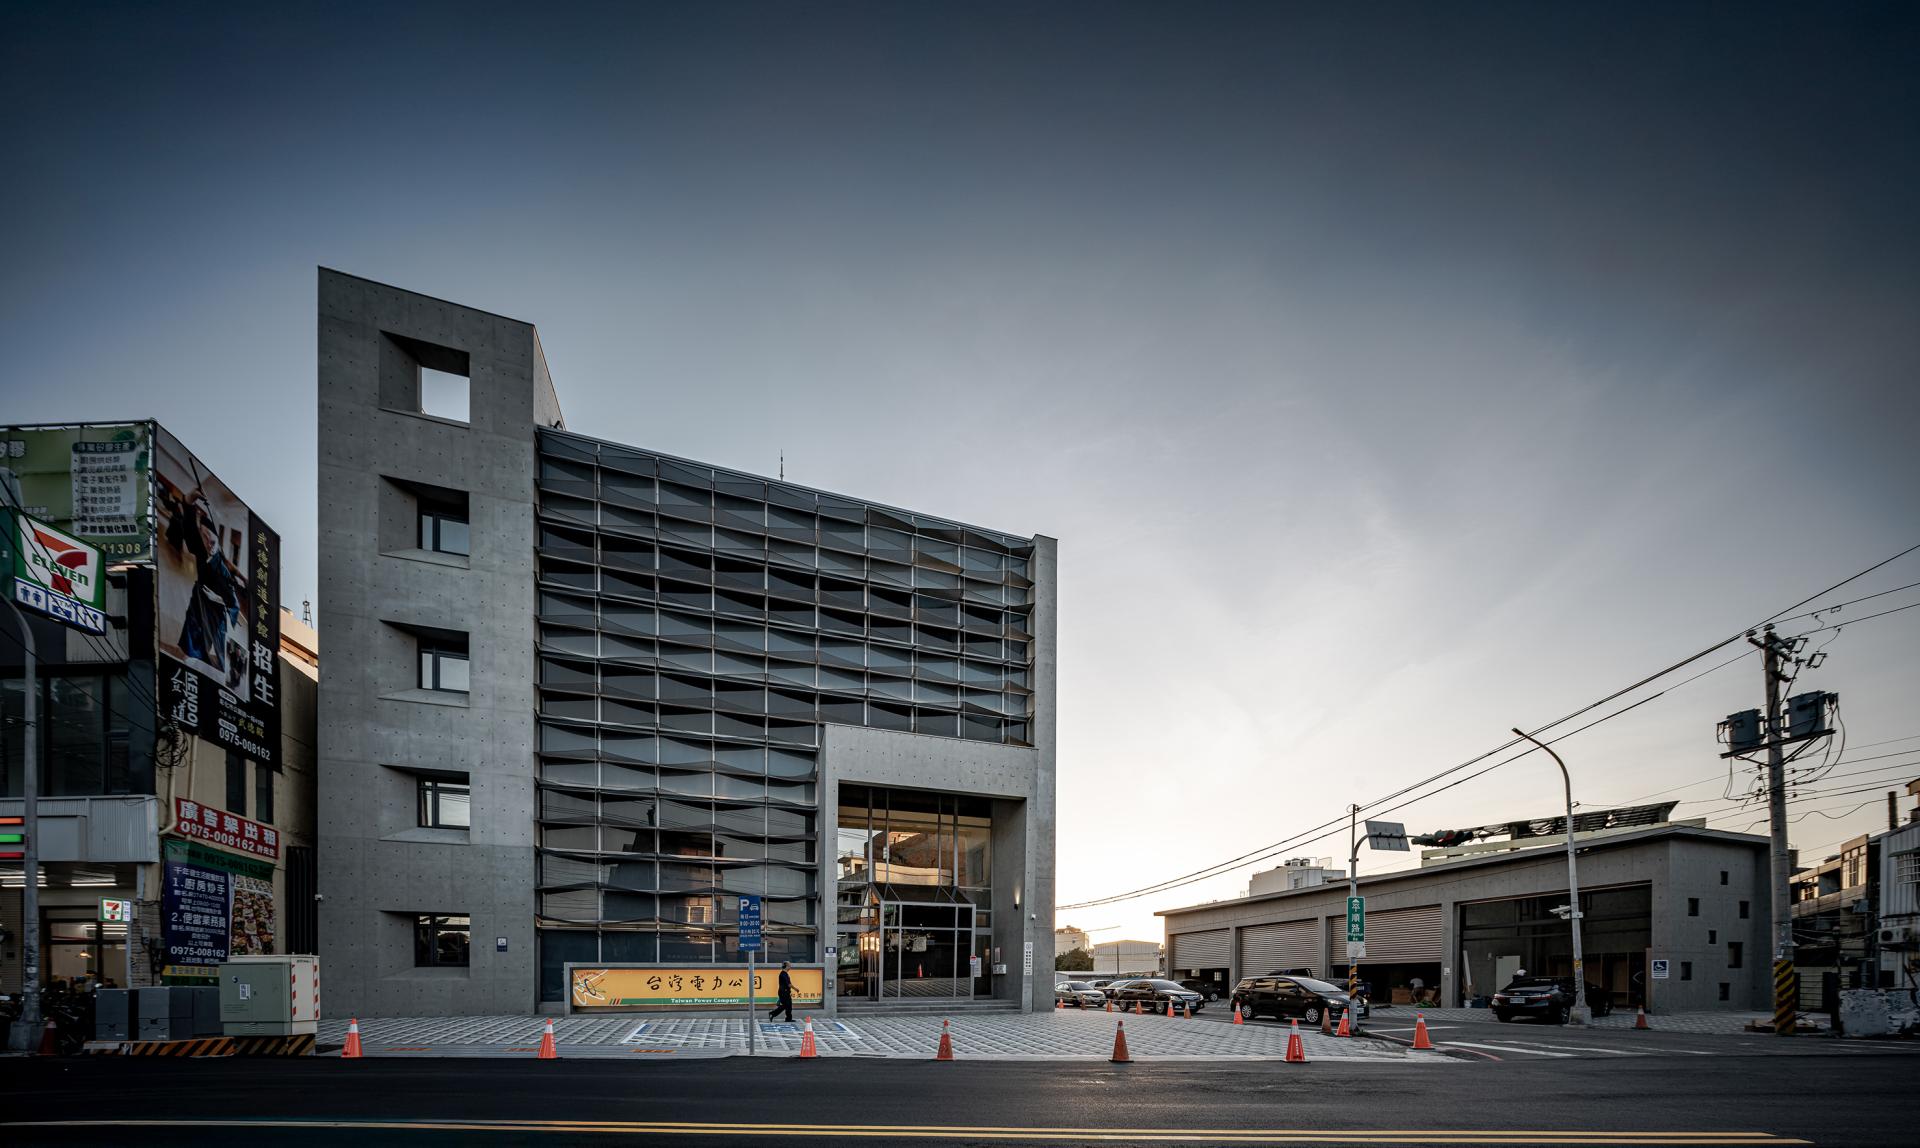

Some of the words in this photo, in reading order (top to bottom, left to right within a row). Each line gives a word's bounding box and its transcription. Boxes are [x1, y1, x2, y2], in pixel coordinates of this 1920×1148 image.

[253, 640, 274, 707] 招生
[187, 672, 199, 724] KENDO
[219, 728, 271, 761] 0975-008162
[179, 800, 276, 846] 廣告架出租
[180, 821, 255, 852] 0975-008162
[740, 899, 749, 911] P
[170, 945, 225, 958] 0975-008162
[646, 974, 762, 992] 台灣電力公司
